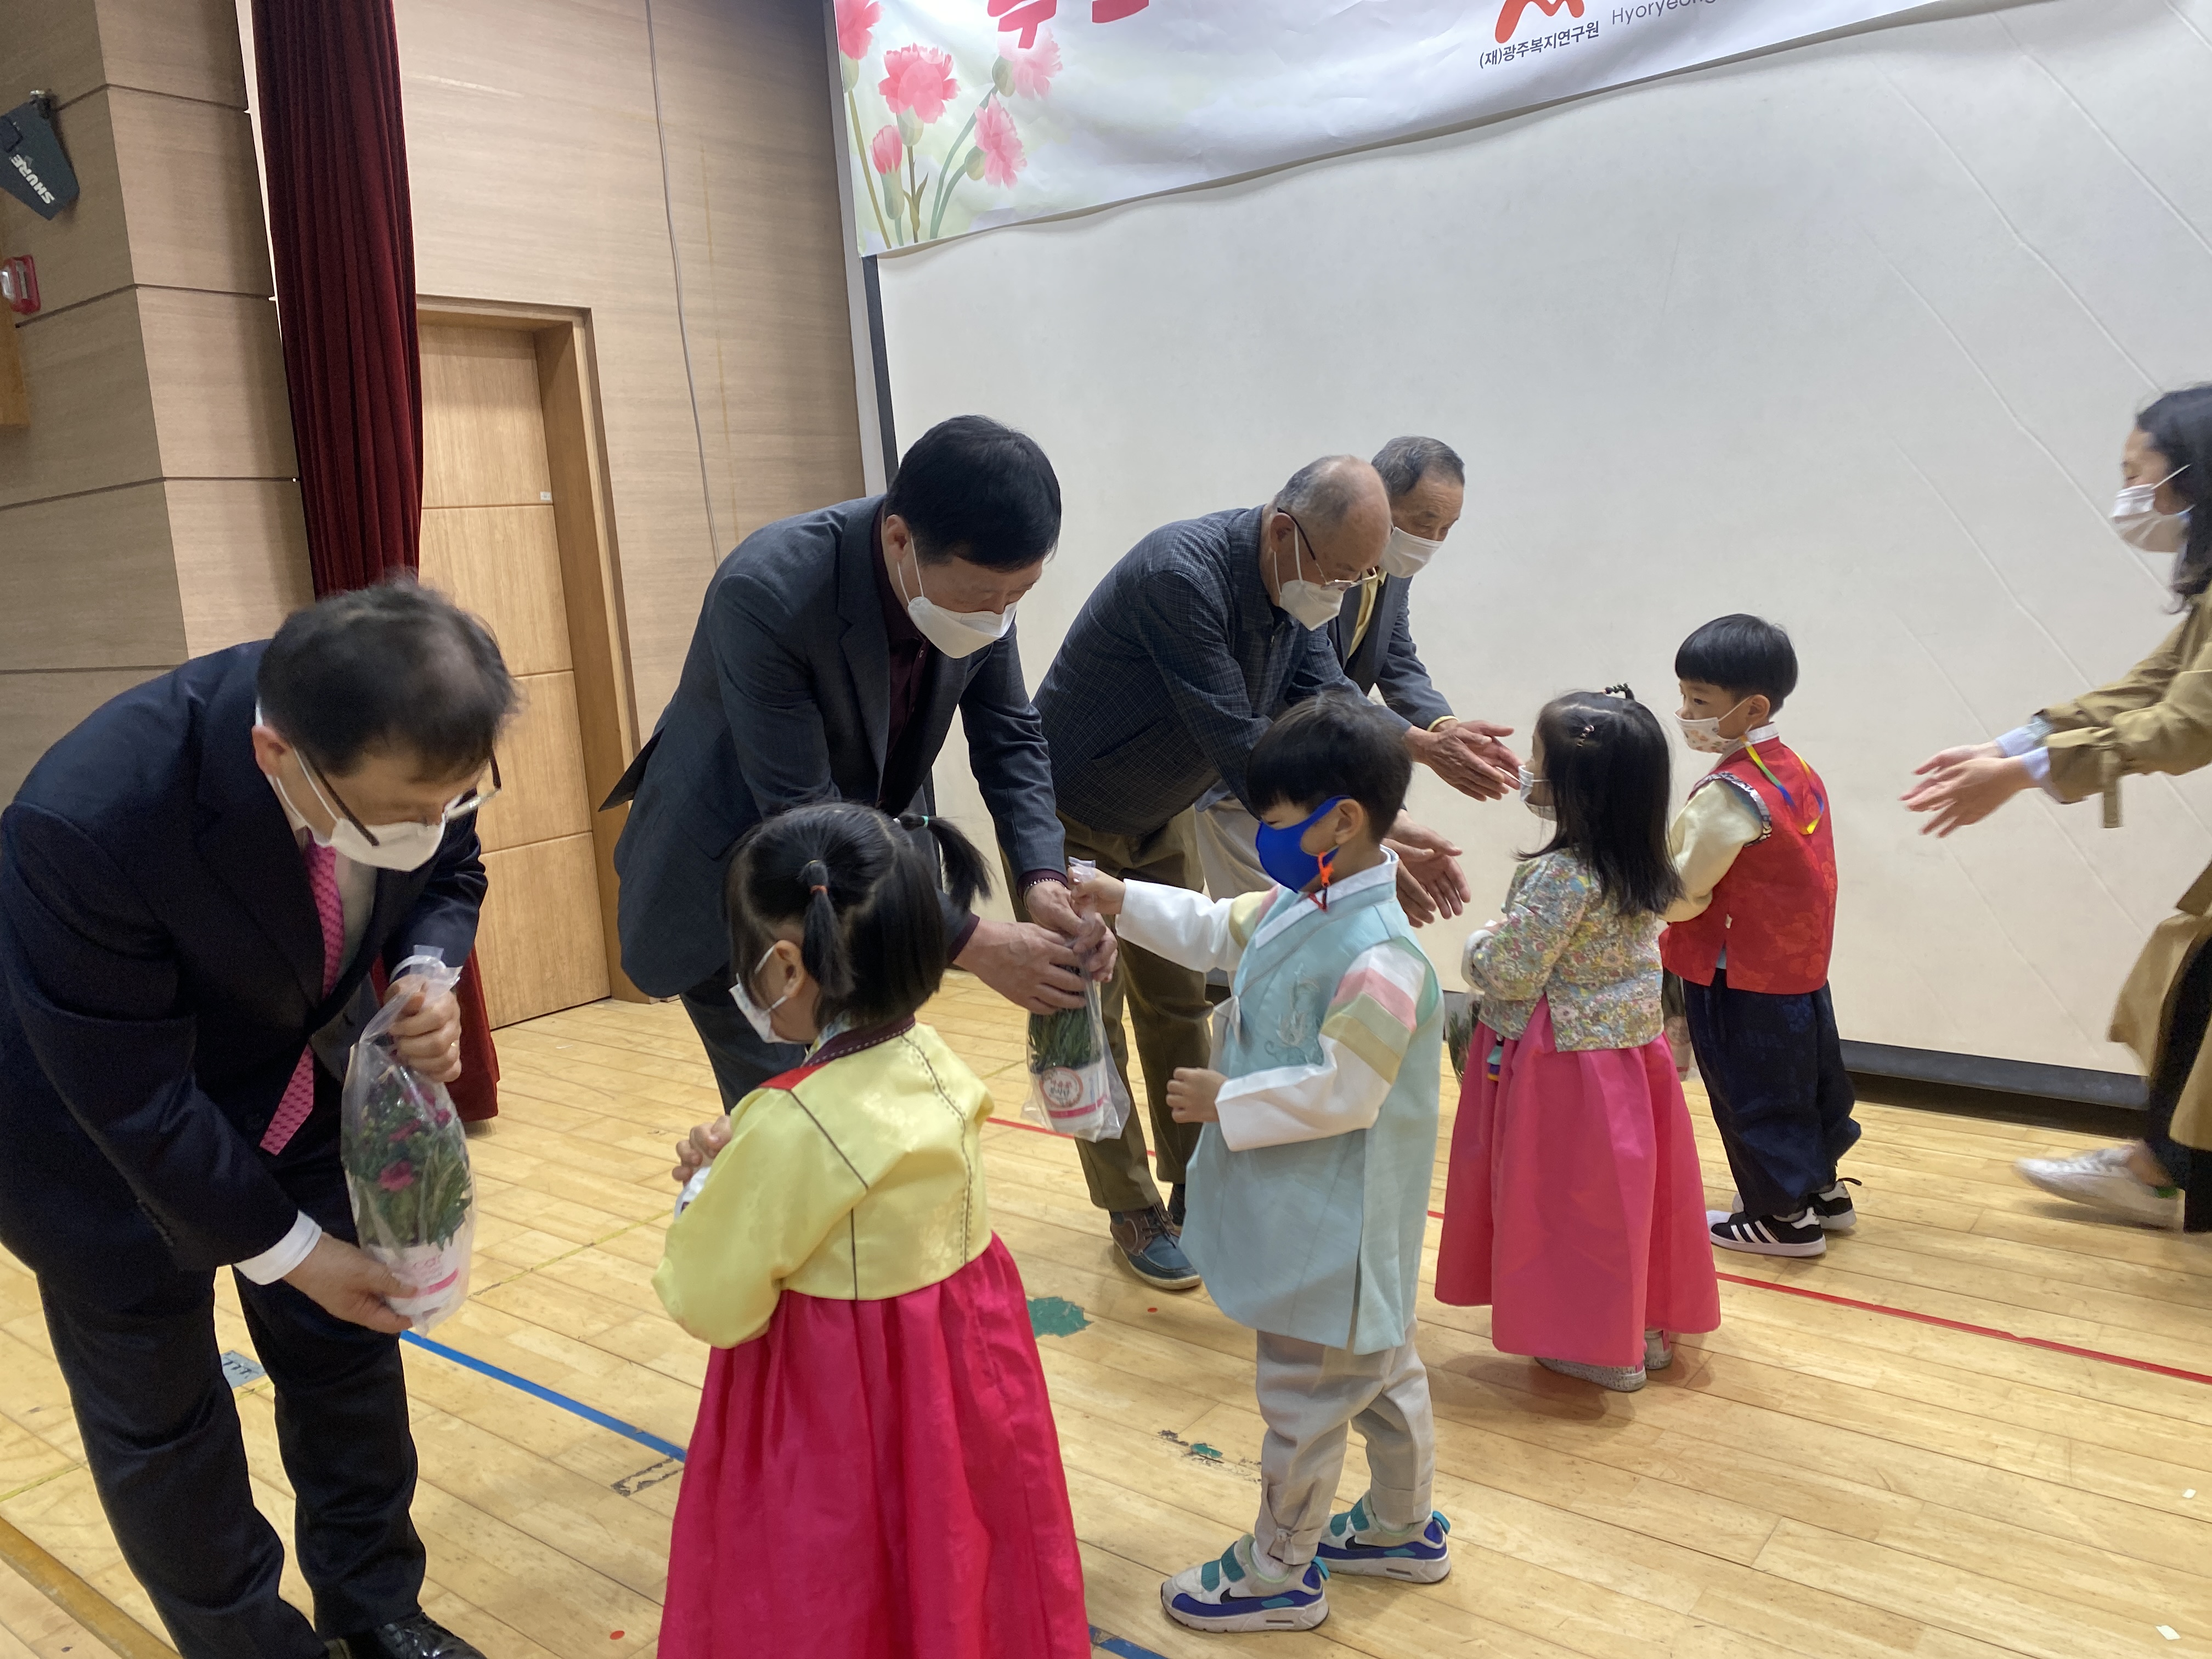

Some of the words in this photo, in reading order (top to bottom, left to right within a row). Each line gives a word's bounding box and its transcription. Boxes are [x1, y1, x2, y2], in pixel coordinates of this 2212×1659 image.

[1612, 0, 1717, 25] Hyoryeo
[1479, 20, 1599, 69] (재)광주복지연구원
[10, 154, 55, 204] SHURE
